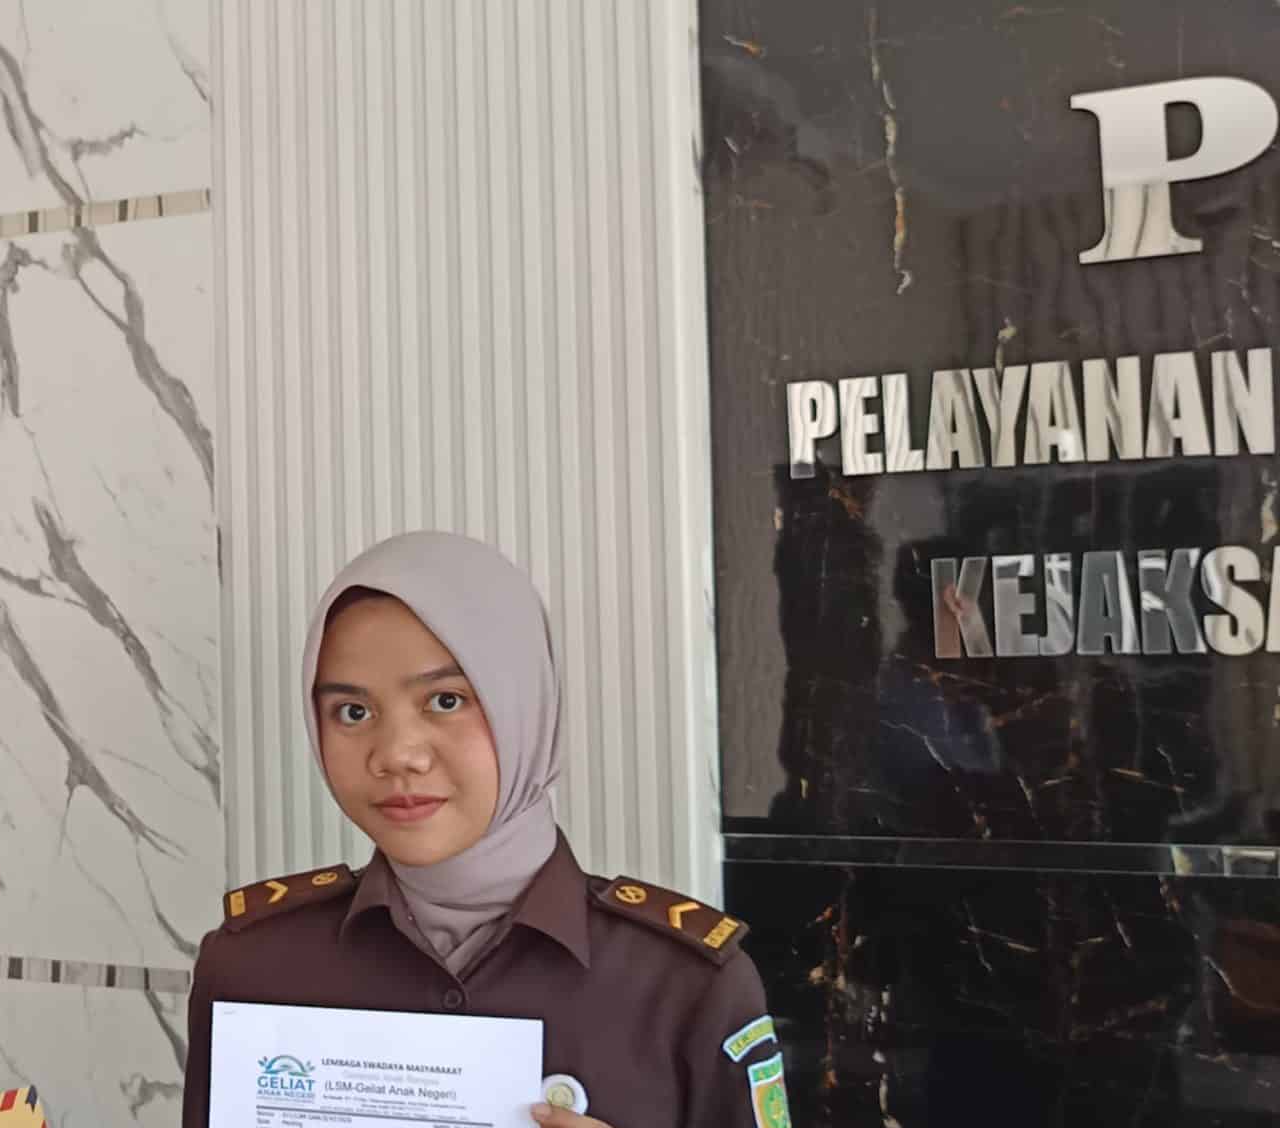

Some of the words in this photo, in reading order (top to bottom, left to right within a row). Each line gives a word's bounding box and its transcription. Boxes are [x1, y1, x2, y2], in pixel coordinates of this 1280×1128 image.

[786, 347, 1276, 480] PELAYANAN
[321, 1058, 361, 1069] LEMBAGA
[257, 1076, 316, 1092] GELIAT
[388, 1084, 416, 1098] Anak
